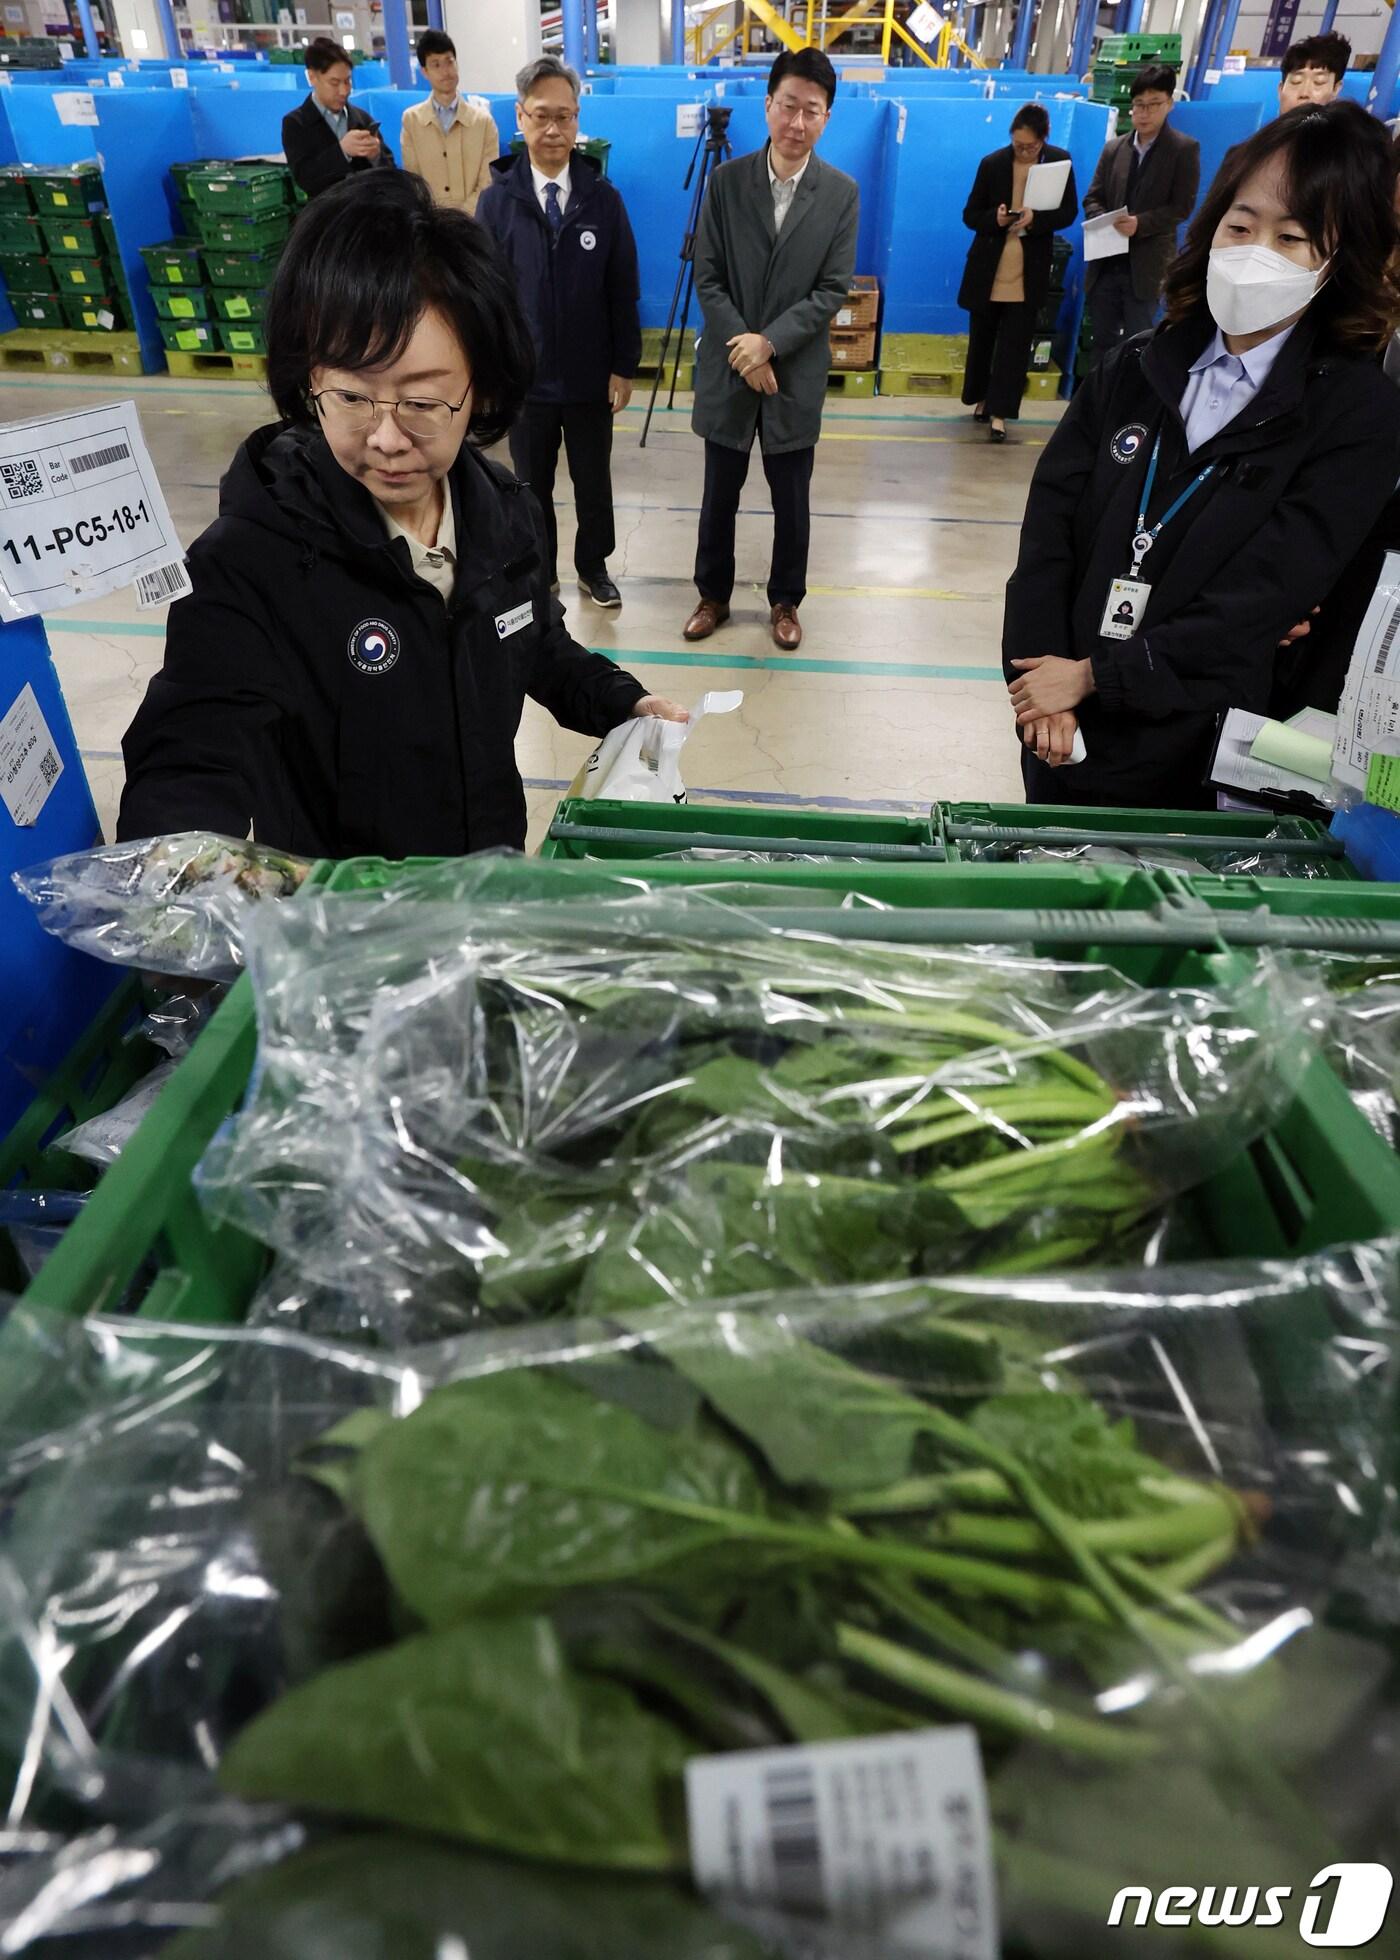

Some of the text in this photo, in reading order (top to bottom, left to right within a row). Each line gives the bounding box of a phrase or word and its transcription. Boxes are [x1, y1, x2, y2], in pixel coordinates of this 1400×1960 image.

[49, 461, 61, 470] Bar
[51, 473, 69, 484] Code
[3, 499, 150, 565] 11-PC5-18-1
